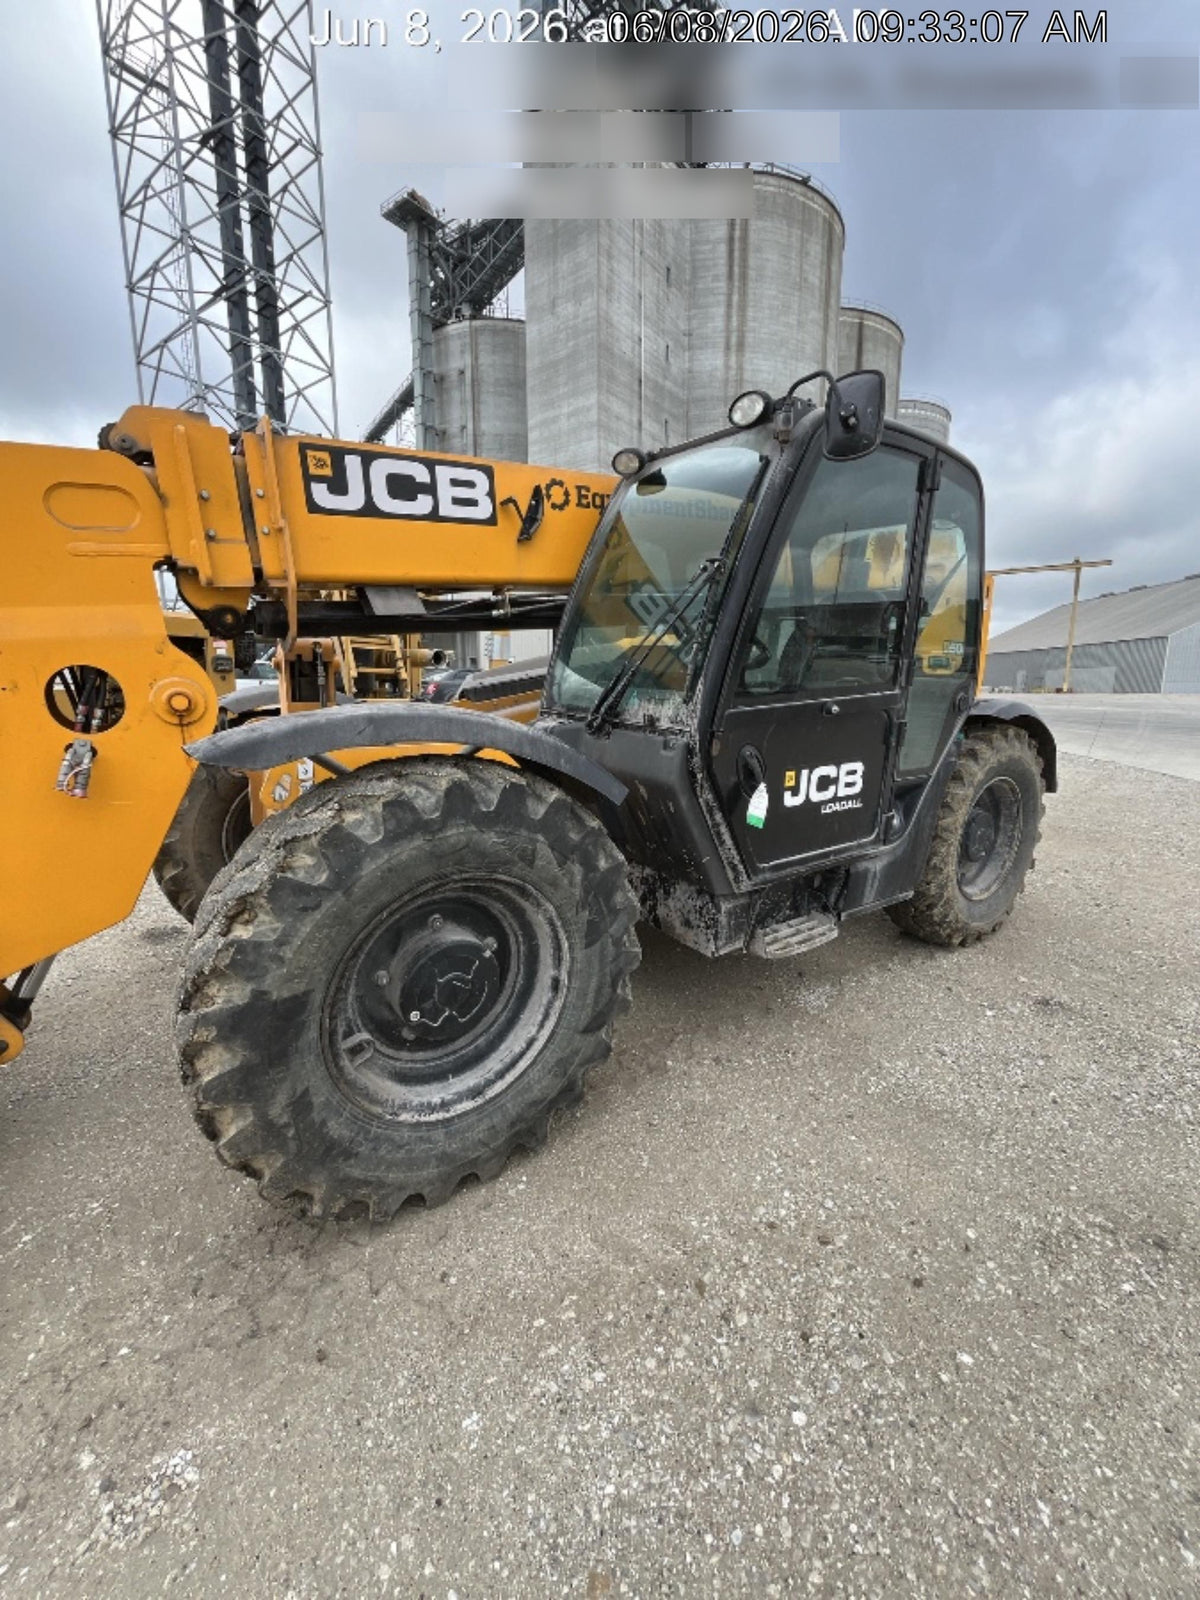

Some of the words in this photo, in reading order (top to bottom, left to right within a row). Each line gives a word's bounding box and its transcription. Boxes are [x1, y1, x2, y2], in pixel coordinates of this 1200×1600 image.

[309, 454, 494, 520] JCB
[783, 761, 864, 808] JCB
[821, 799, 863, 814] LOADALL
